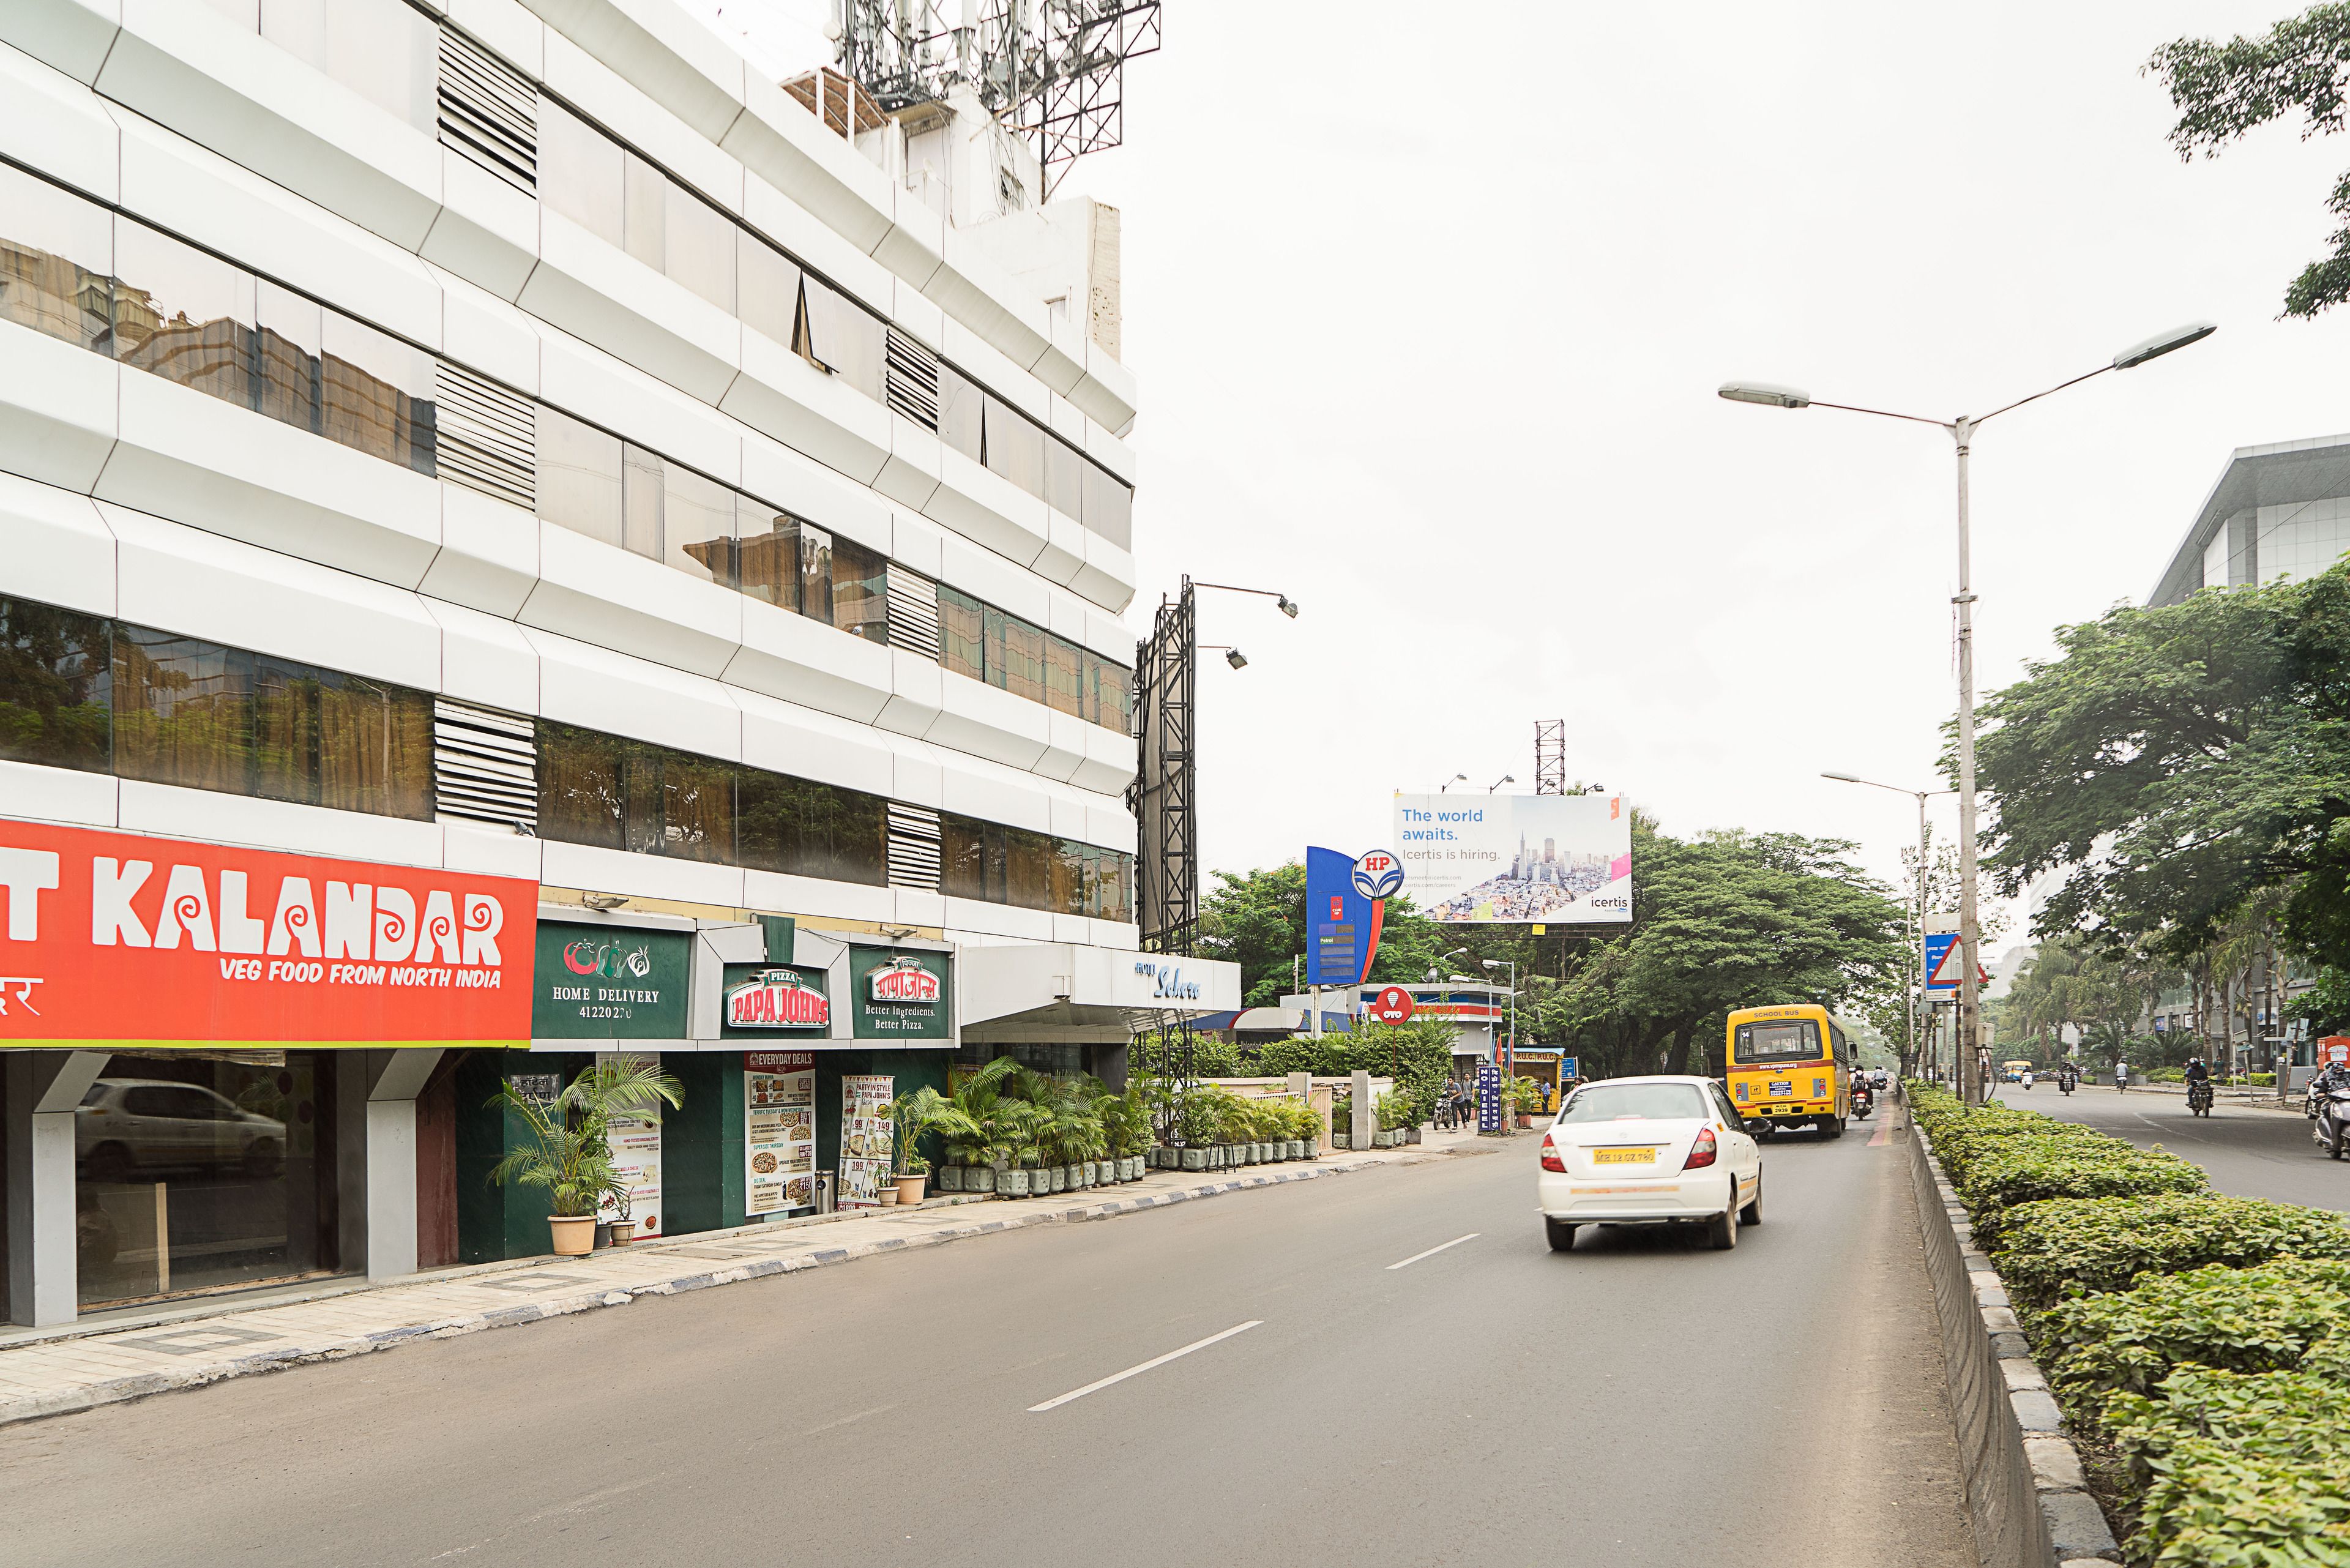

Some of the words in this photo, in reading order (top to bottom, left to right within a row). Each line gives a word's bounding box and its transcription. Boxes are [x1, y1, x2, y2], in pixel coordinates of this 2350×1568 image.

[1402, 809, 1431, 821] The
[1438, 809, 1483, 821] world
[1403, 827, 1458, 840] awaits.
[1403, 849, 1441, 859] Icertis
[1447, 849, 1455, 859] is
[1461, 849, 1500, 861] hiring.
[1365, 857, 1389, 870] HP
[1591, 896, 1627, 907] icertis
[92, 856, 504, 966] KALANDAR
[220, 958, 261, 980] VEG
[268, 960, 323, 983] FOOD
[329, 963, 386, 985] FROM
[390, 966, 453, 987] NORTH
[455, 969, 501, 988] INDIA
[771, 972, 796, 982] PIZZA
[876, 972, 905, 997] पापा
[553, 987, 590, 1000] HOME
[598, 988, 659, 1002] DELIVERY
[733, 988, 775, 1021] PAPA
[776, 988, 828, 1023] JOHN'S
[865, 1004, 889, 1015] Better
[892, 1006, 935, 1018] Ingredients.
[875, 1019, 899, 1029] Better
[902, 1020, 923, 1029] Pizza.
[759, 1053, 791, 1065] EVERYDAY
[793, 1053, 811, 1064] DEALS
[807, 1112, 811, 1124] 1
